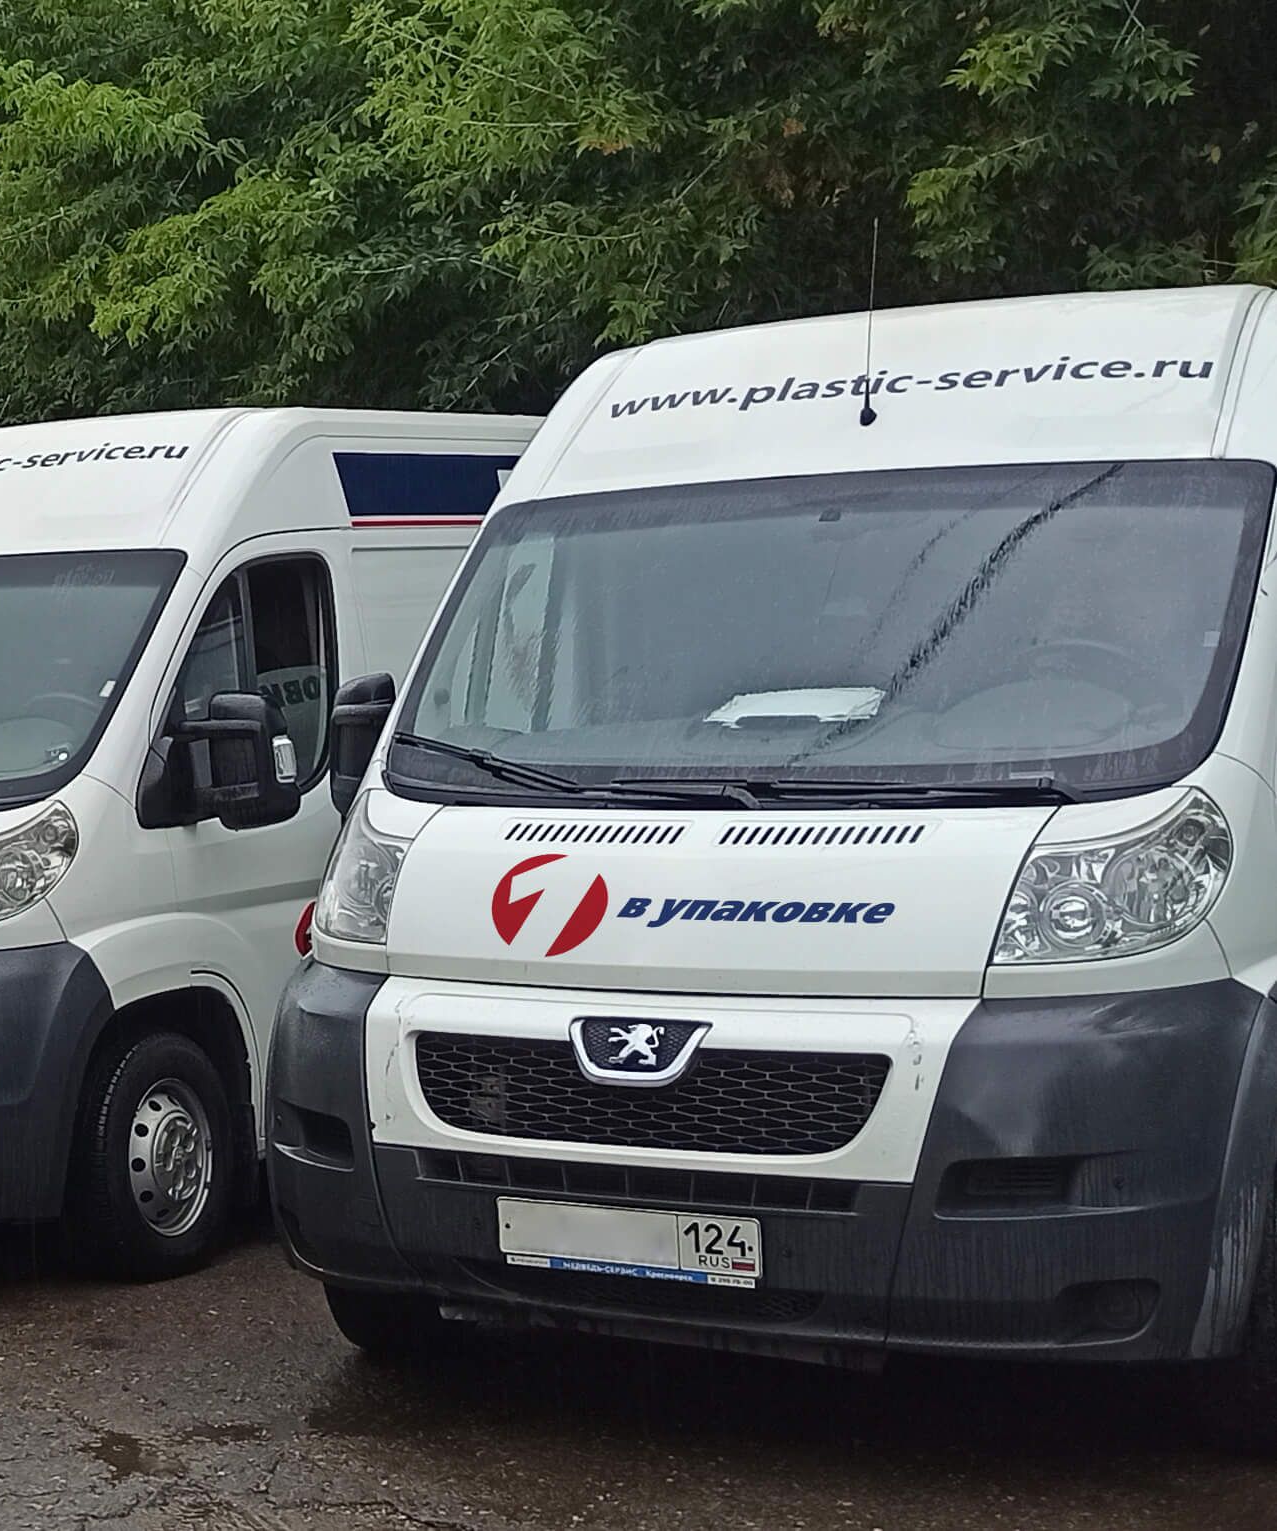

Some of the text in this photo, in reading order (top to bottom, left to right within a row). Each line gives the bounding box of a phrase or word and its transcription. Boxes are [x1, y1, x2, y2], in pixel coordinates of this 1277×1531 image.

[610, 355, 1215, 418] www.plastic-service.ru
[616, 896, 653, 918] в
[646, 898, 896, 929] упаковке
[682, 1221, 748, 1257] 124
[697, 1255, 731, 1270] RUS
